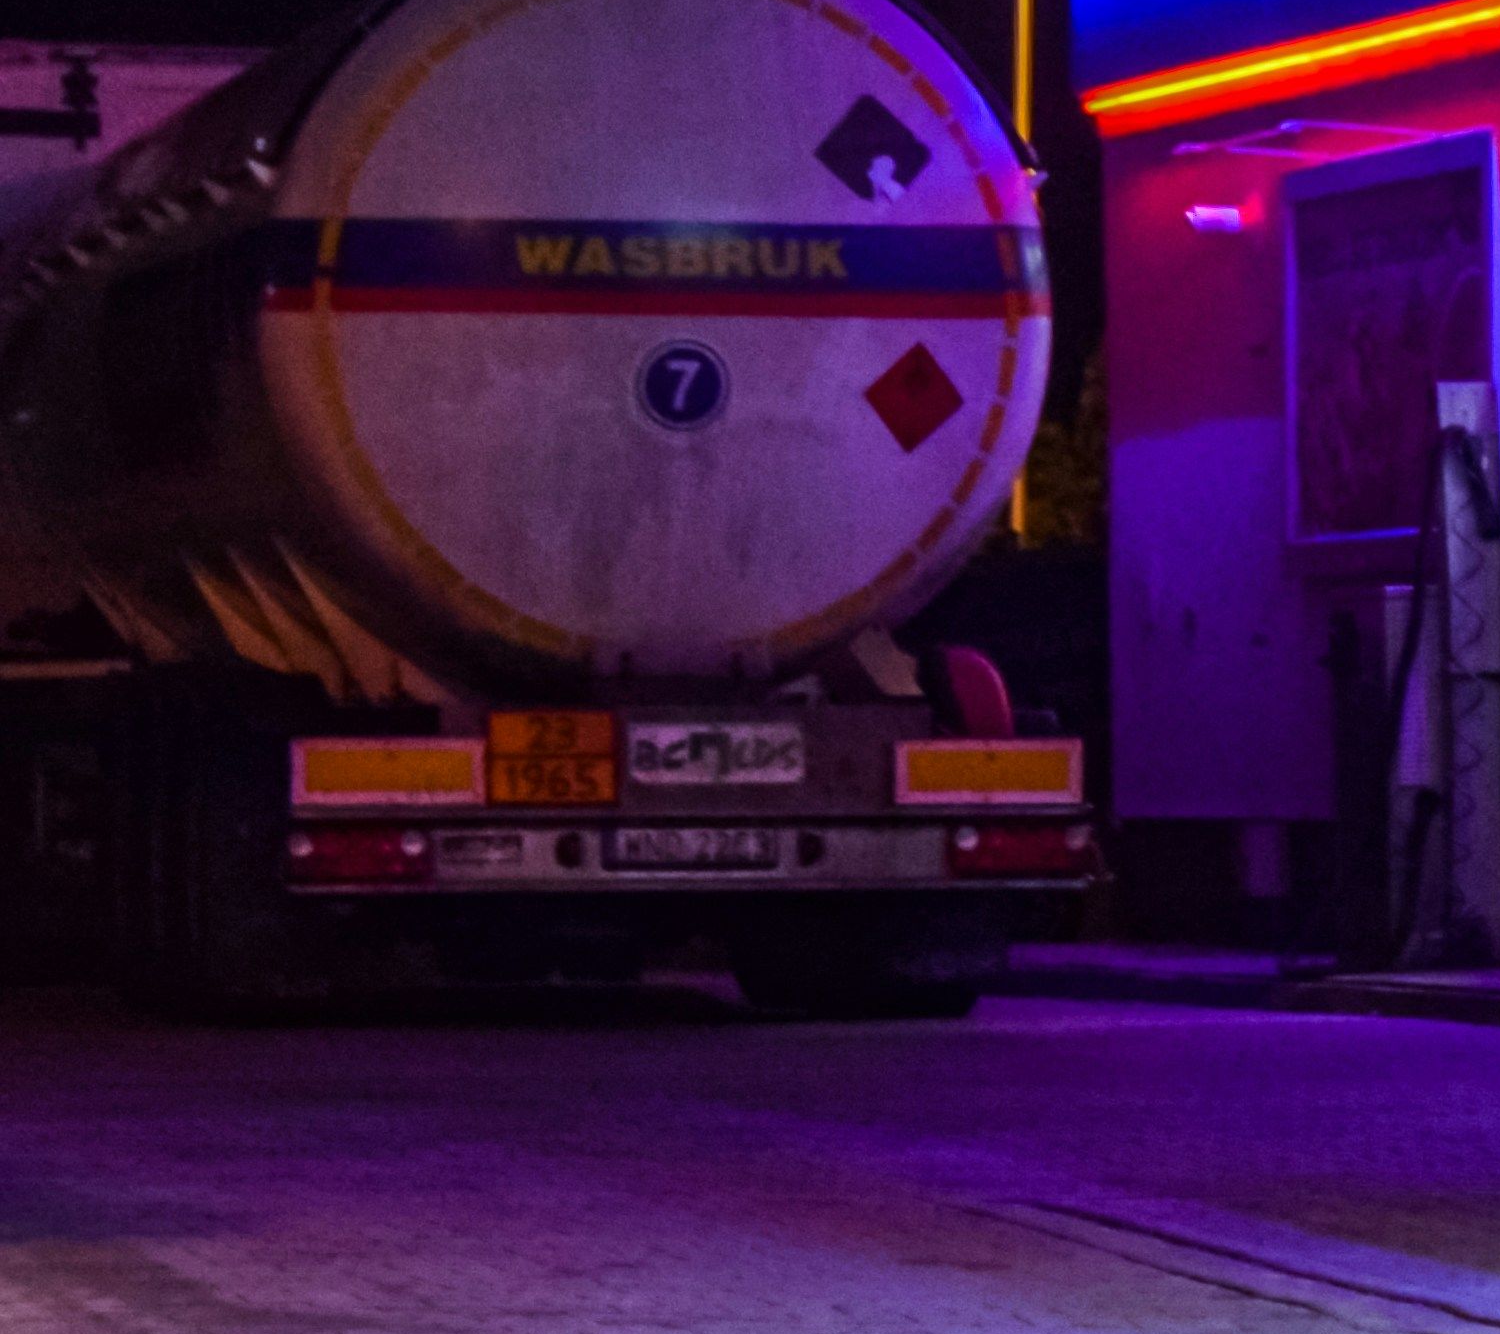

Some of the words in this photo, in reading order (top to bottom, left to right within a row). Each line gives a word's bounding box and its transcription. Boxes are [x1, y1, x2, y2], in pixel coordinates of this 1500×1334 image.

[514, 234, 848, 279] WASBRUK
[664, 358, 702, 411] 7
[504, 761, 600, 797] 1965
